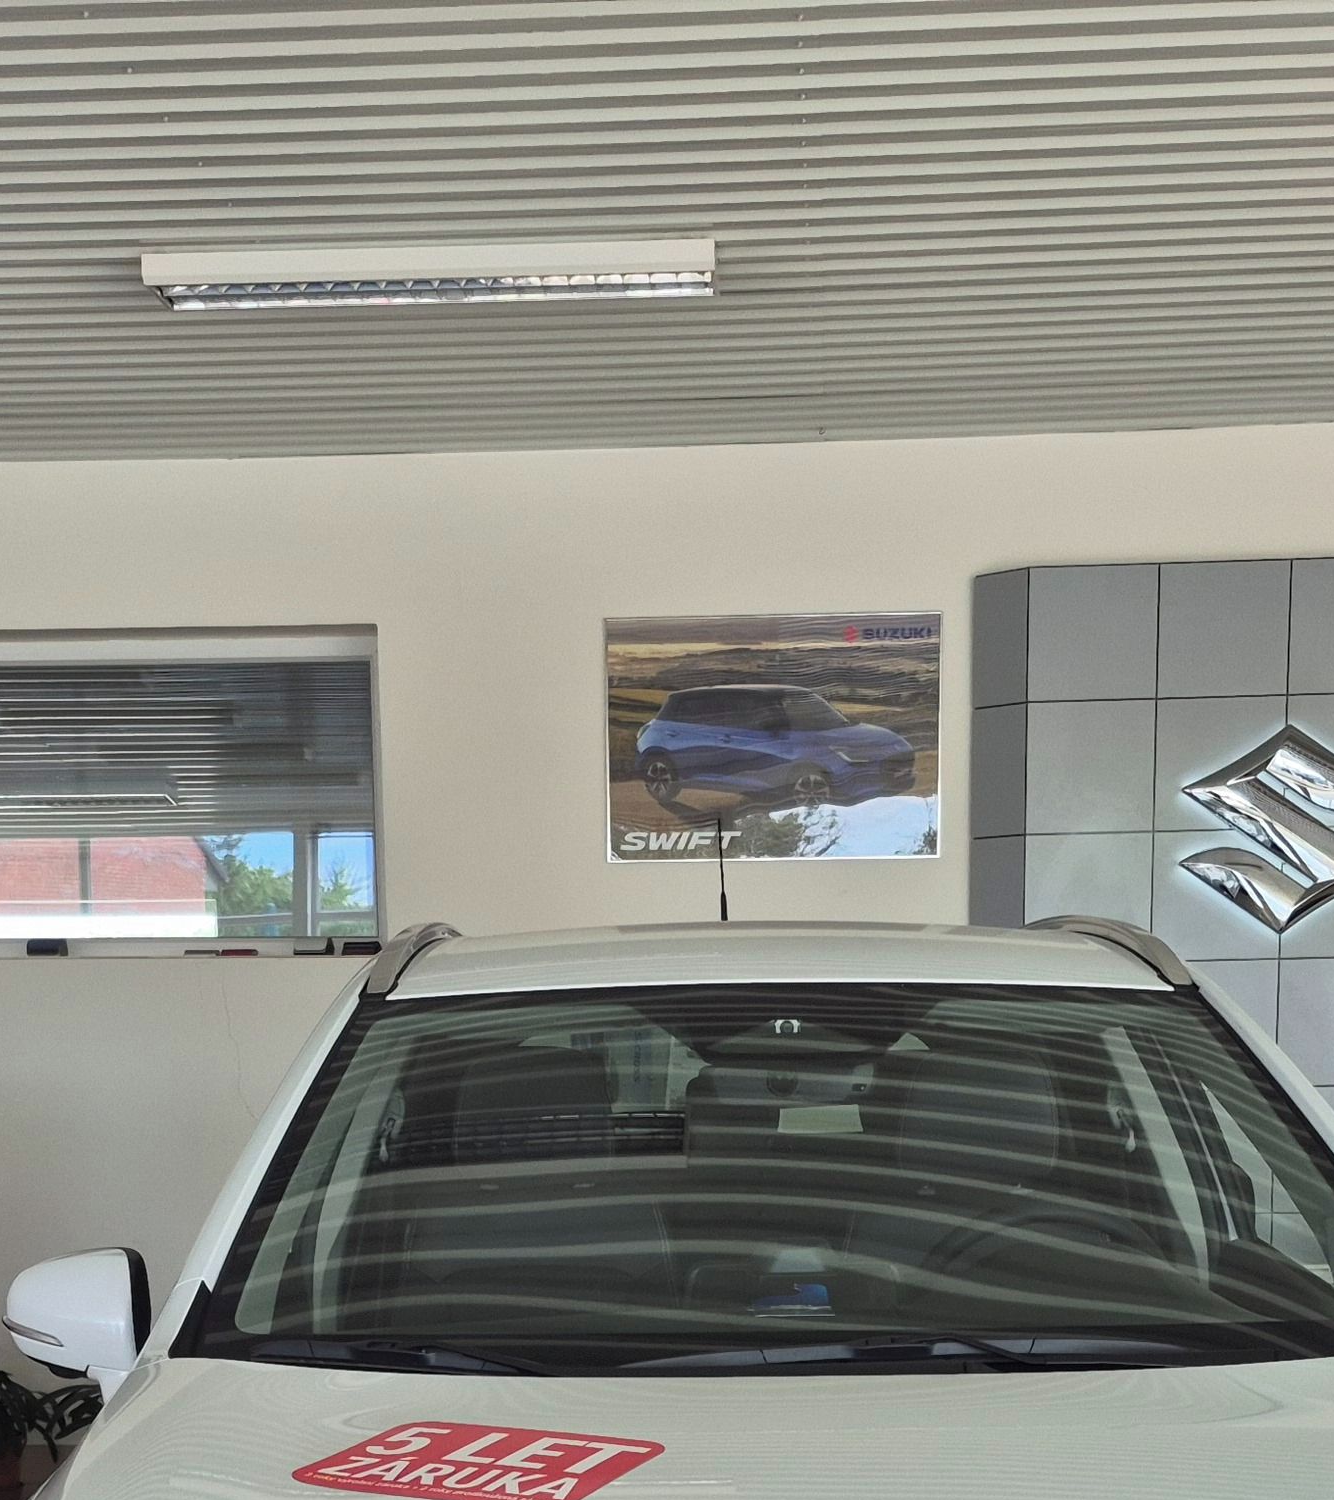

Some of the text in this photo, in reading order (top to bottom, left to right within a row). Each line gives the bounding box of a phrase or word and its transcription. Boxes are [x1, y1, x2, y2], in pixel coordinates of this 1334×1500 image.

[861, 626, 933, 642] SUZUKI
[620, 830, 742, 852] SWIFT
[365, 1426, 652, 1475] 5 LET
[320, 1456, 580, 1500] ZÁRUKA
